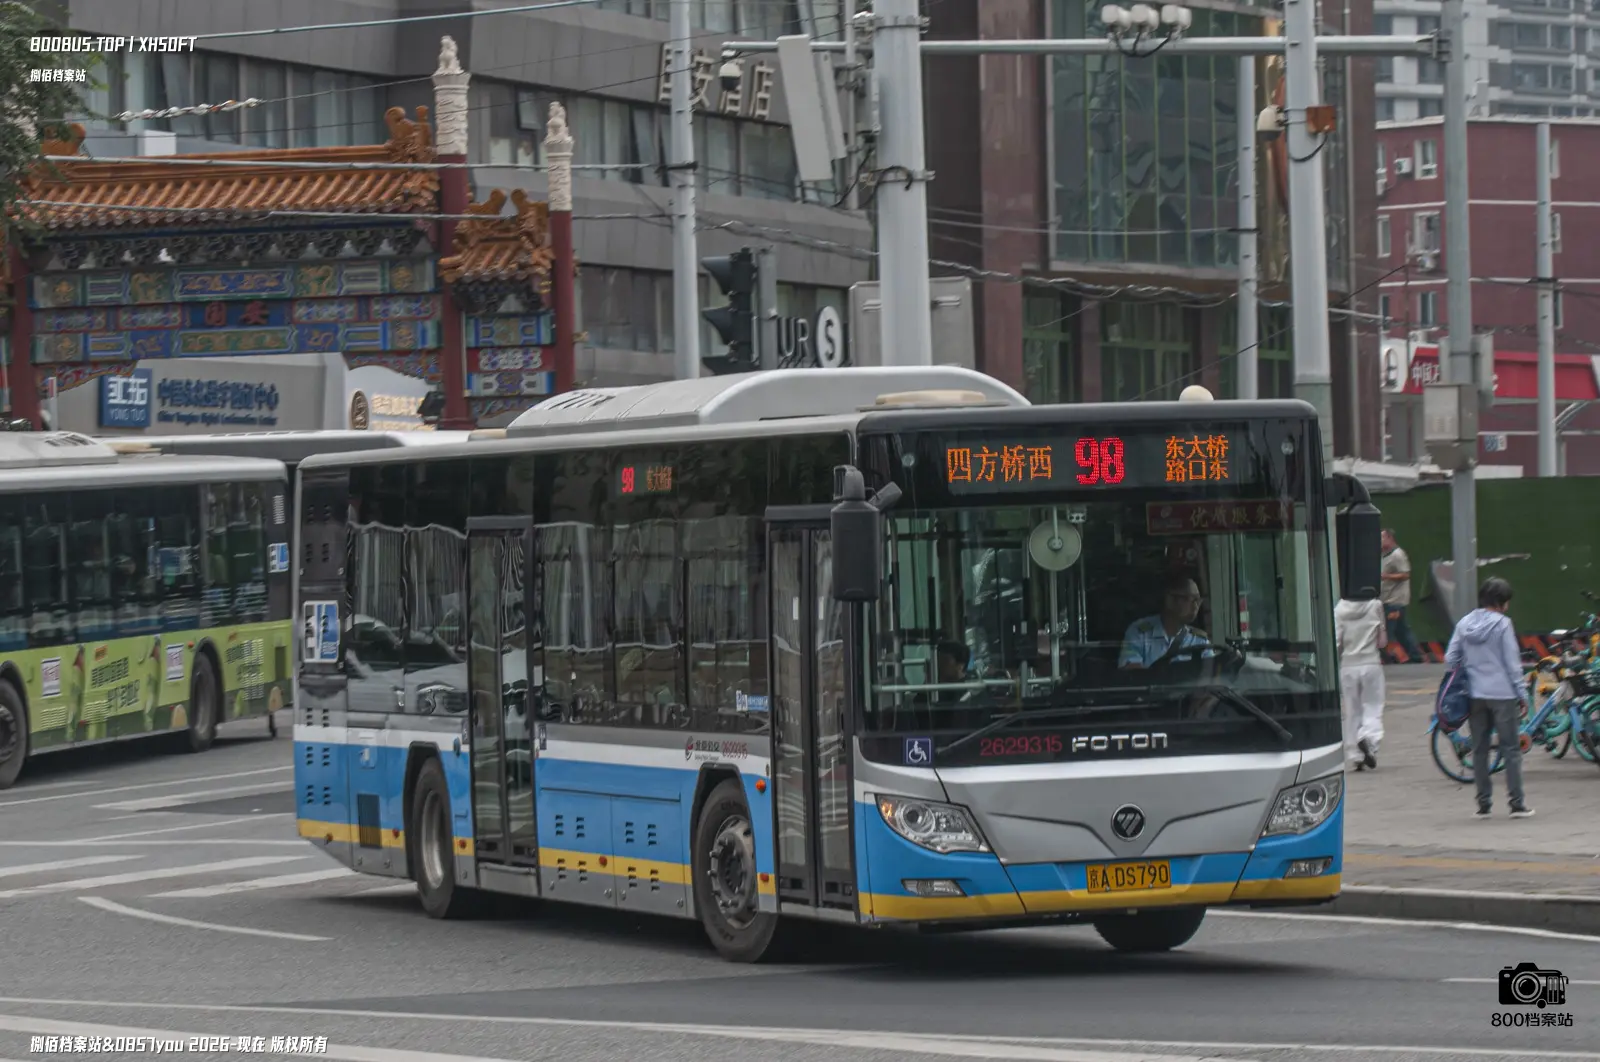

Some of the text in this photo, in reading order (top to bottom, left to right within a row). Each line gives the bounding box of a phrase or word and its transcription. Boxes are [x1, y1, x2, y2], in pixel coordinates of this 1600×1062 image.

[1165, 434, 1229, 459] 东大桥
[947, 445, 1052, 483] 四方桥西
[1074, 436, 1125, 485] 98
[1165, 459, 1229, 482] 路口东
[980, 735, 1063, 757] 2629315
[1072, 732, 1168, 753] FOTON
